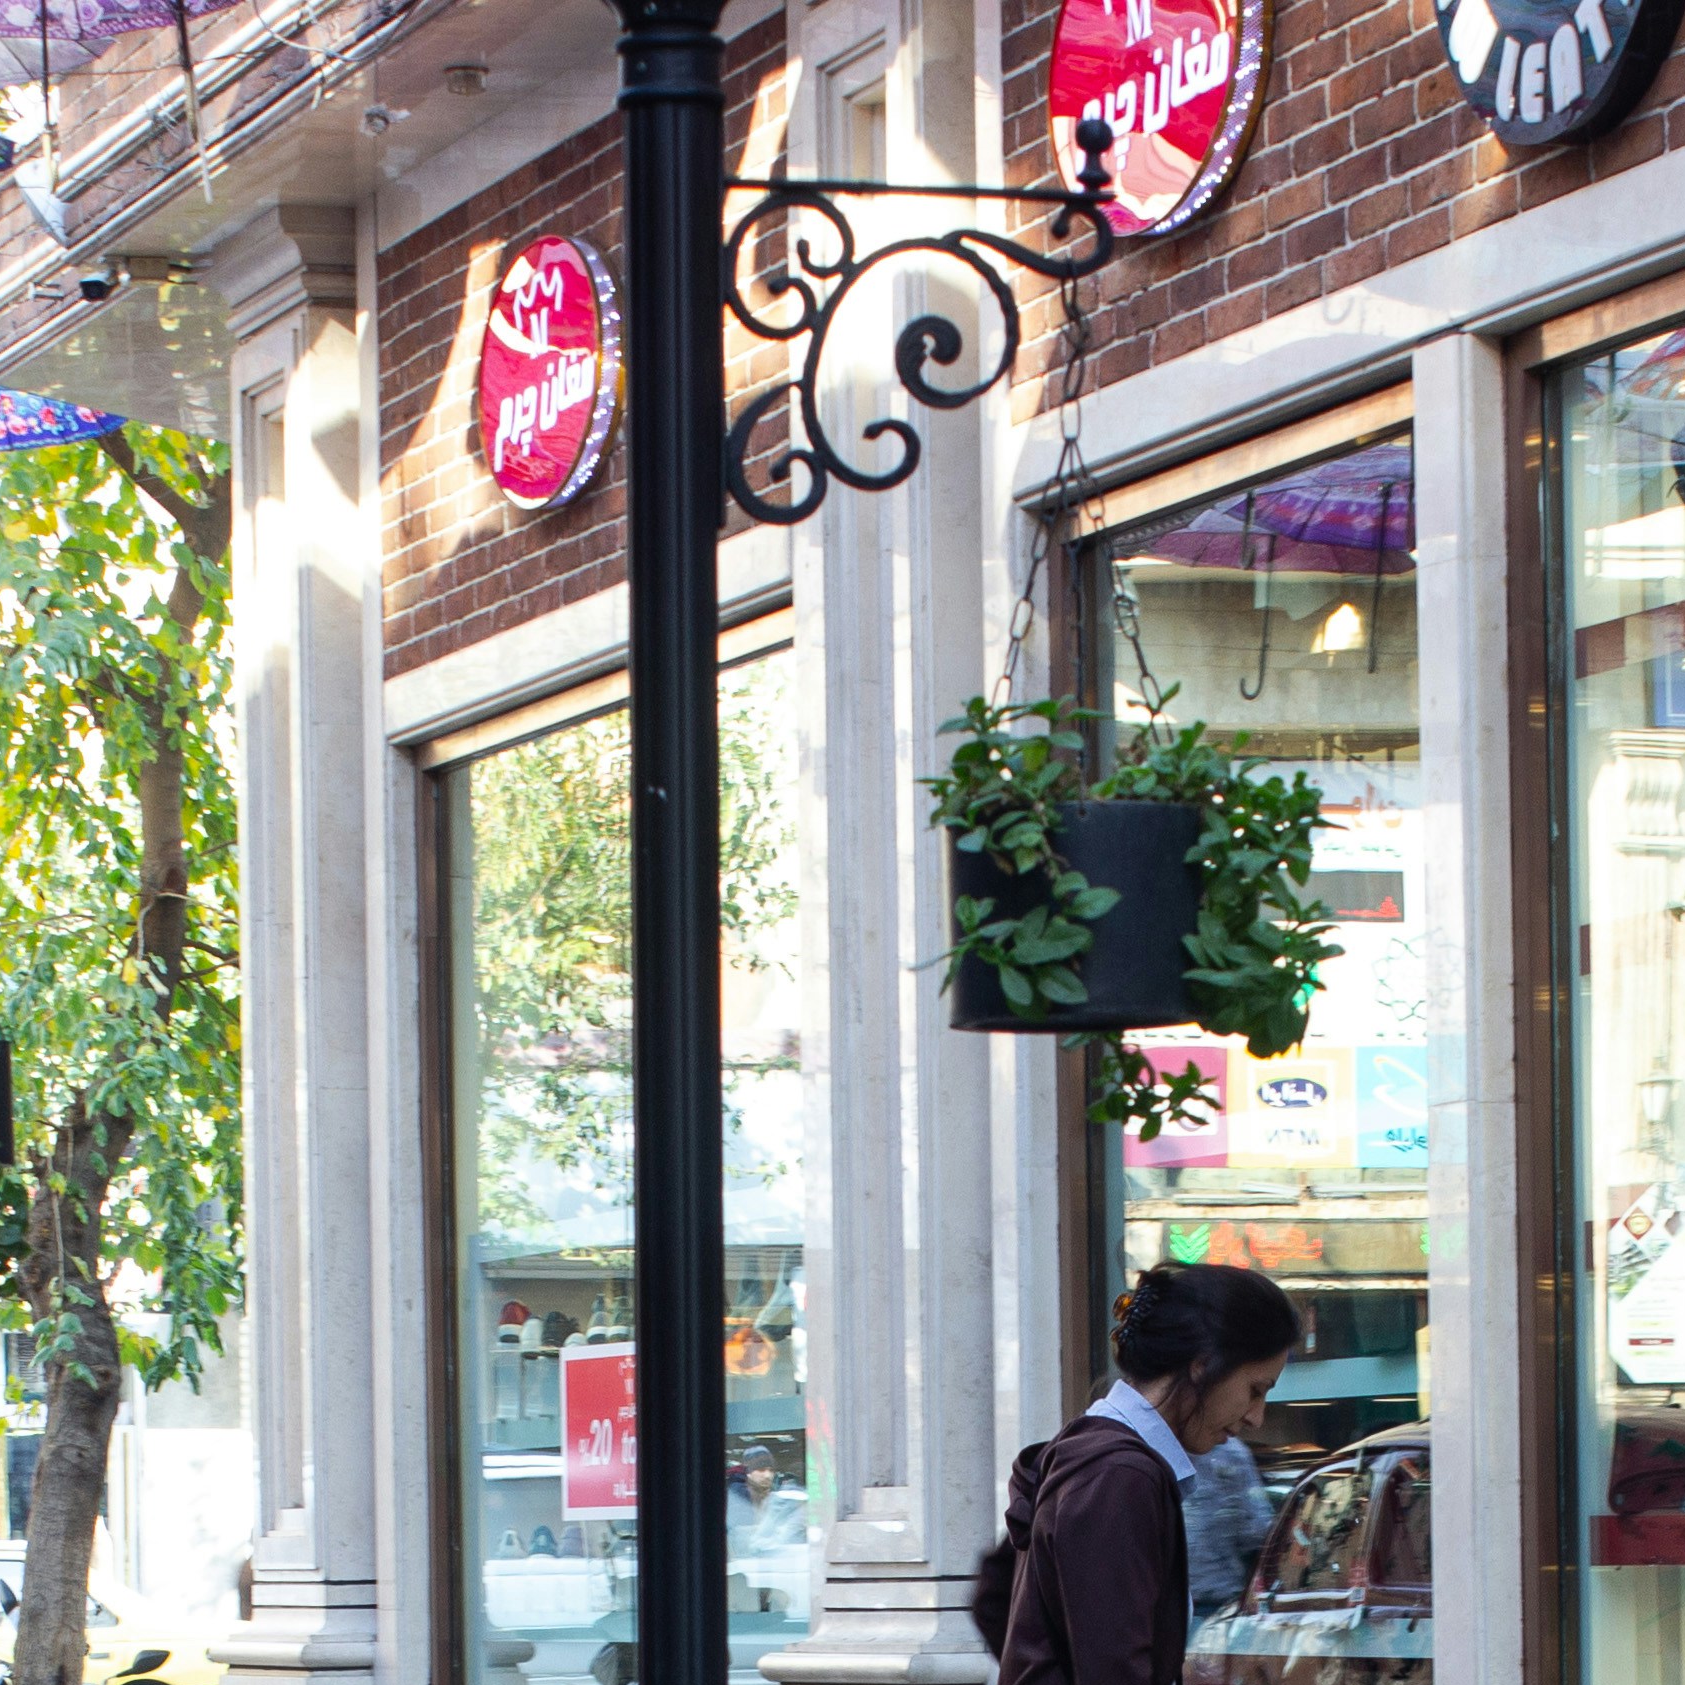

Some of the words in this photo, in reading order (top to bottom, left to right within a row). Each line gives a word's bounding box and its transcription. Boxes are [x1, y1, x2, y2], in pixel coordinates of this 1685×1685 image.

[1142, 27, 1231, 138] مغان
[1495, 0, 1633, 123] LEAT
[493, 385, 538, 473] چرم
[539, 352, 596, 432] مغان
